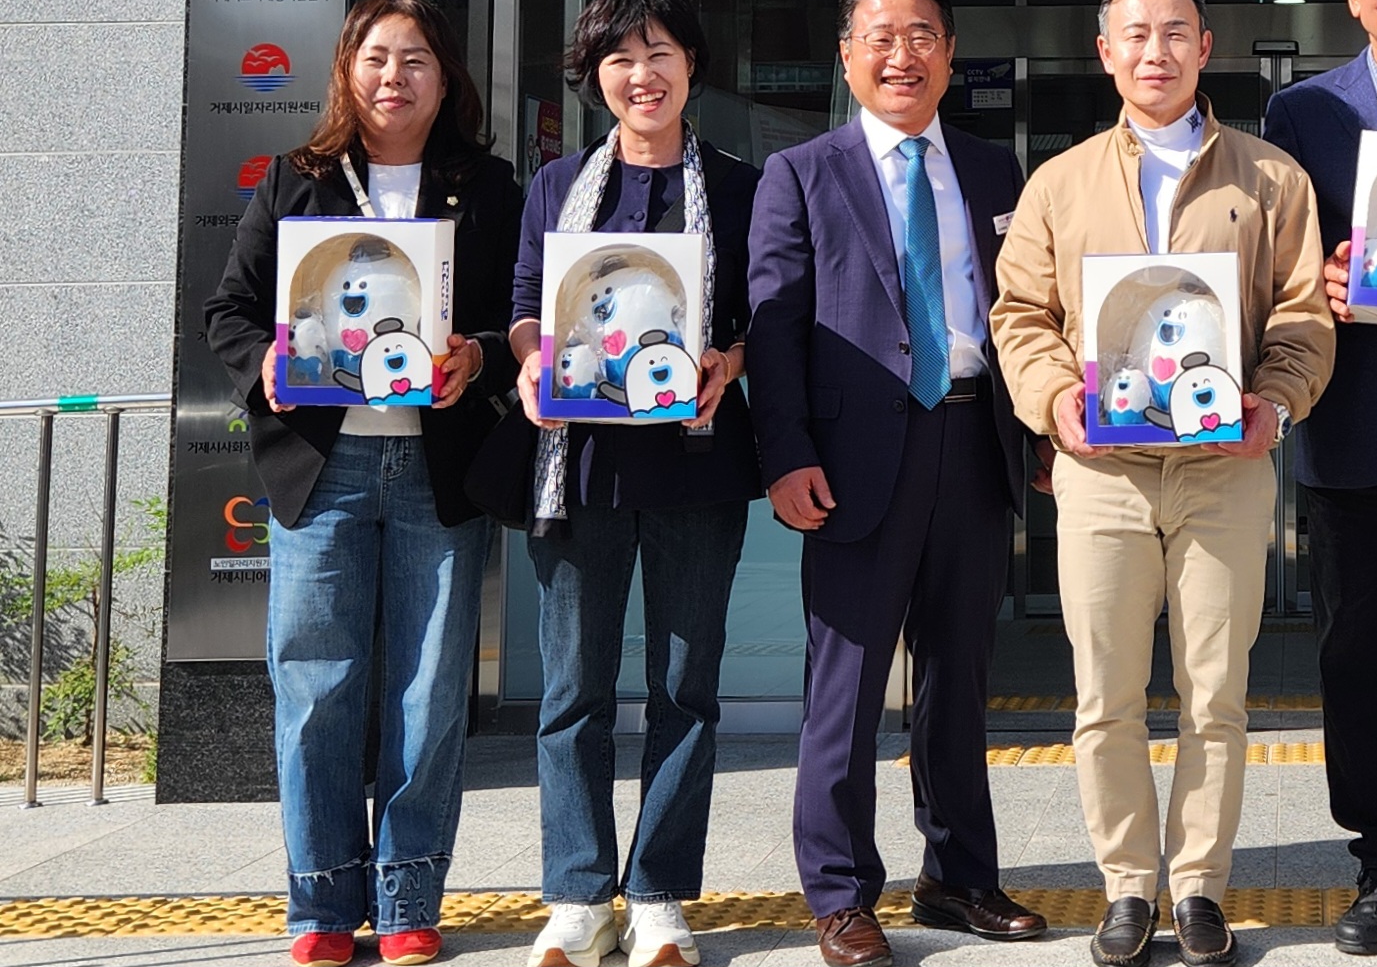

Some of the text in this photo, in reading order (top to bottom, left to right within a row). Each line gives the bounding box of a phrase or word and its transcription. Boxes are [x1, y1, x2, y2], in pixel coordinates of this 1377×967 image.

[210, 100, 321, 114] 거제시일자리지원센터
[195, 214, 243, 227] 거제외국
[210, 570, 270, 584] 거제시니어
